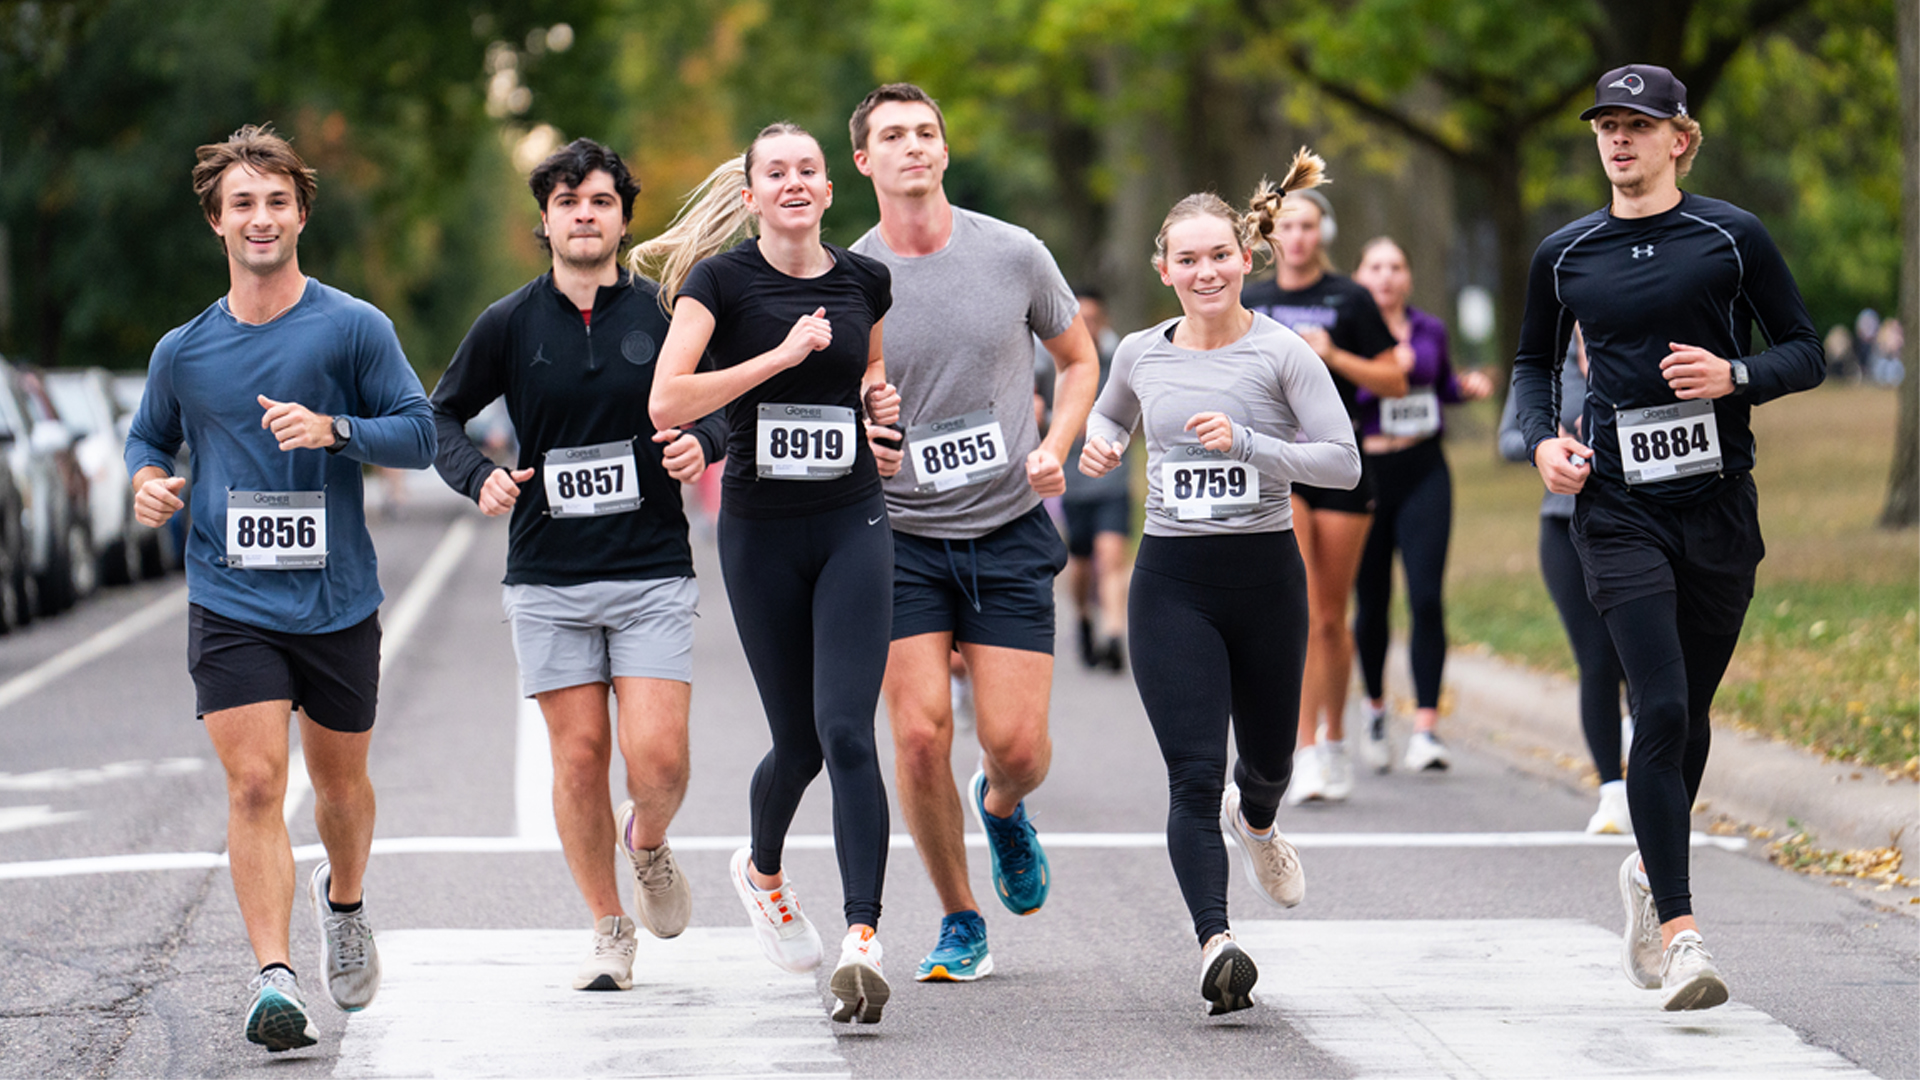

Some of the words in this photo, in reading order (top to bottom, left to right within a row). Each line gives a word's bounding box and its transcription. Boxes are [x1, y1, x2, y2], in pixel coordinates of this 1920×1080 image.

[770, 427, 843, 460] 8919
[922, 432, 996, 474] 8855
[1630, 422, 1709, 463] 8884
[557, 464, 624, 499] 8857
[1174, 466, 1247, 499] 8759
[237, 515, 316, 548] 8856
